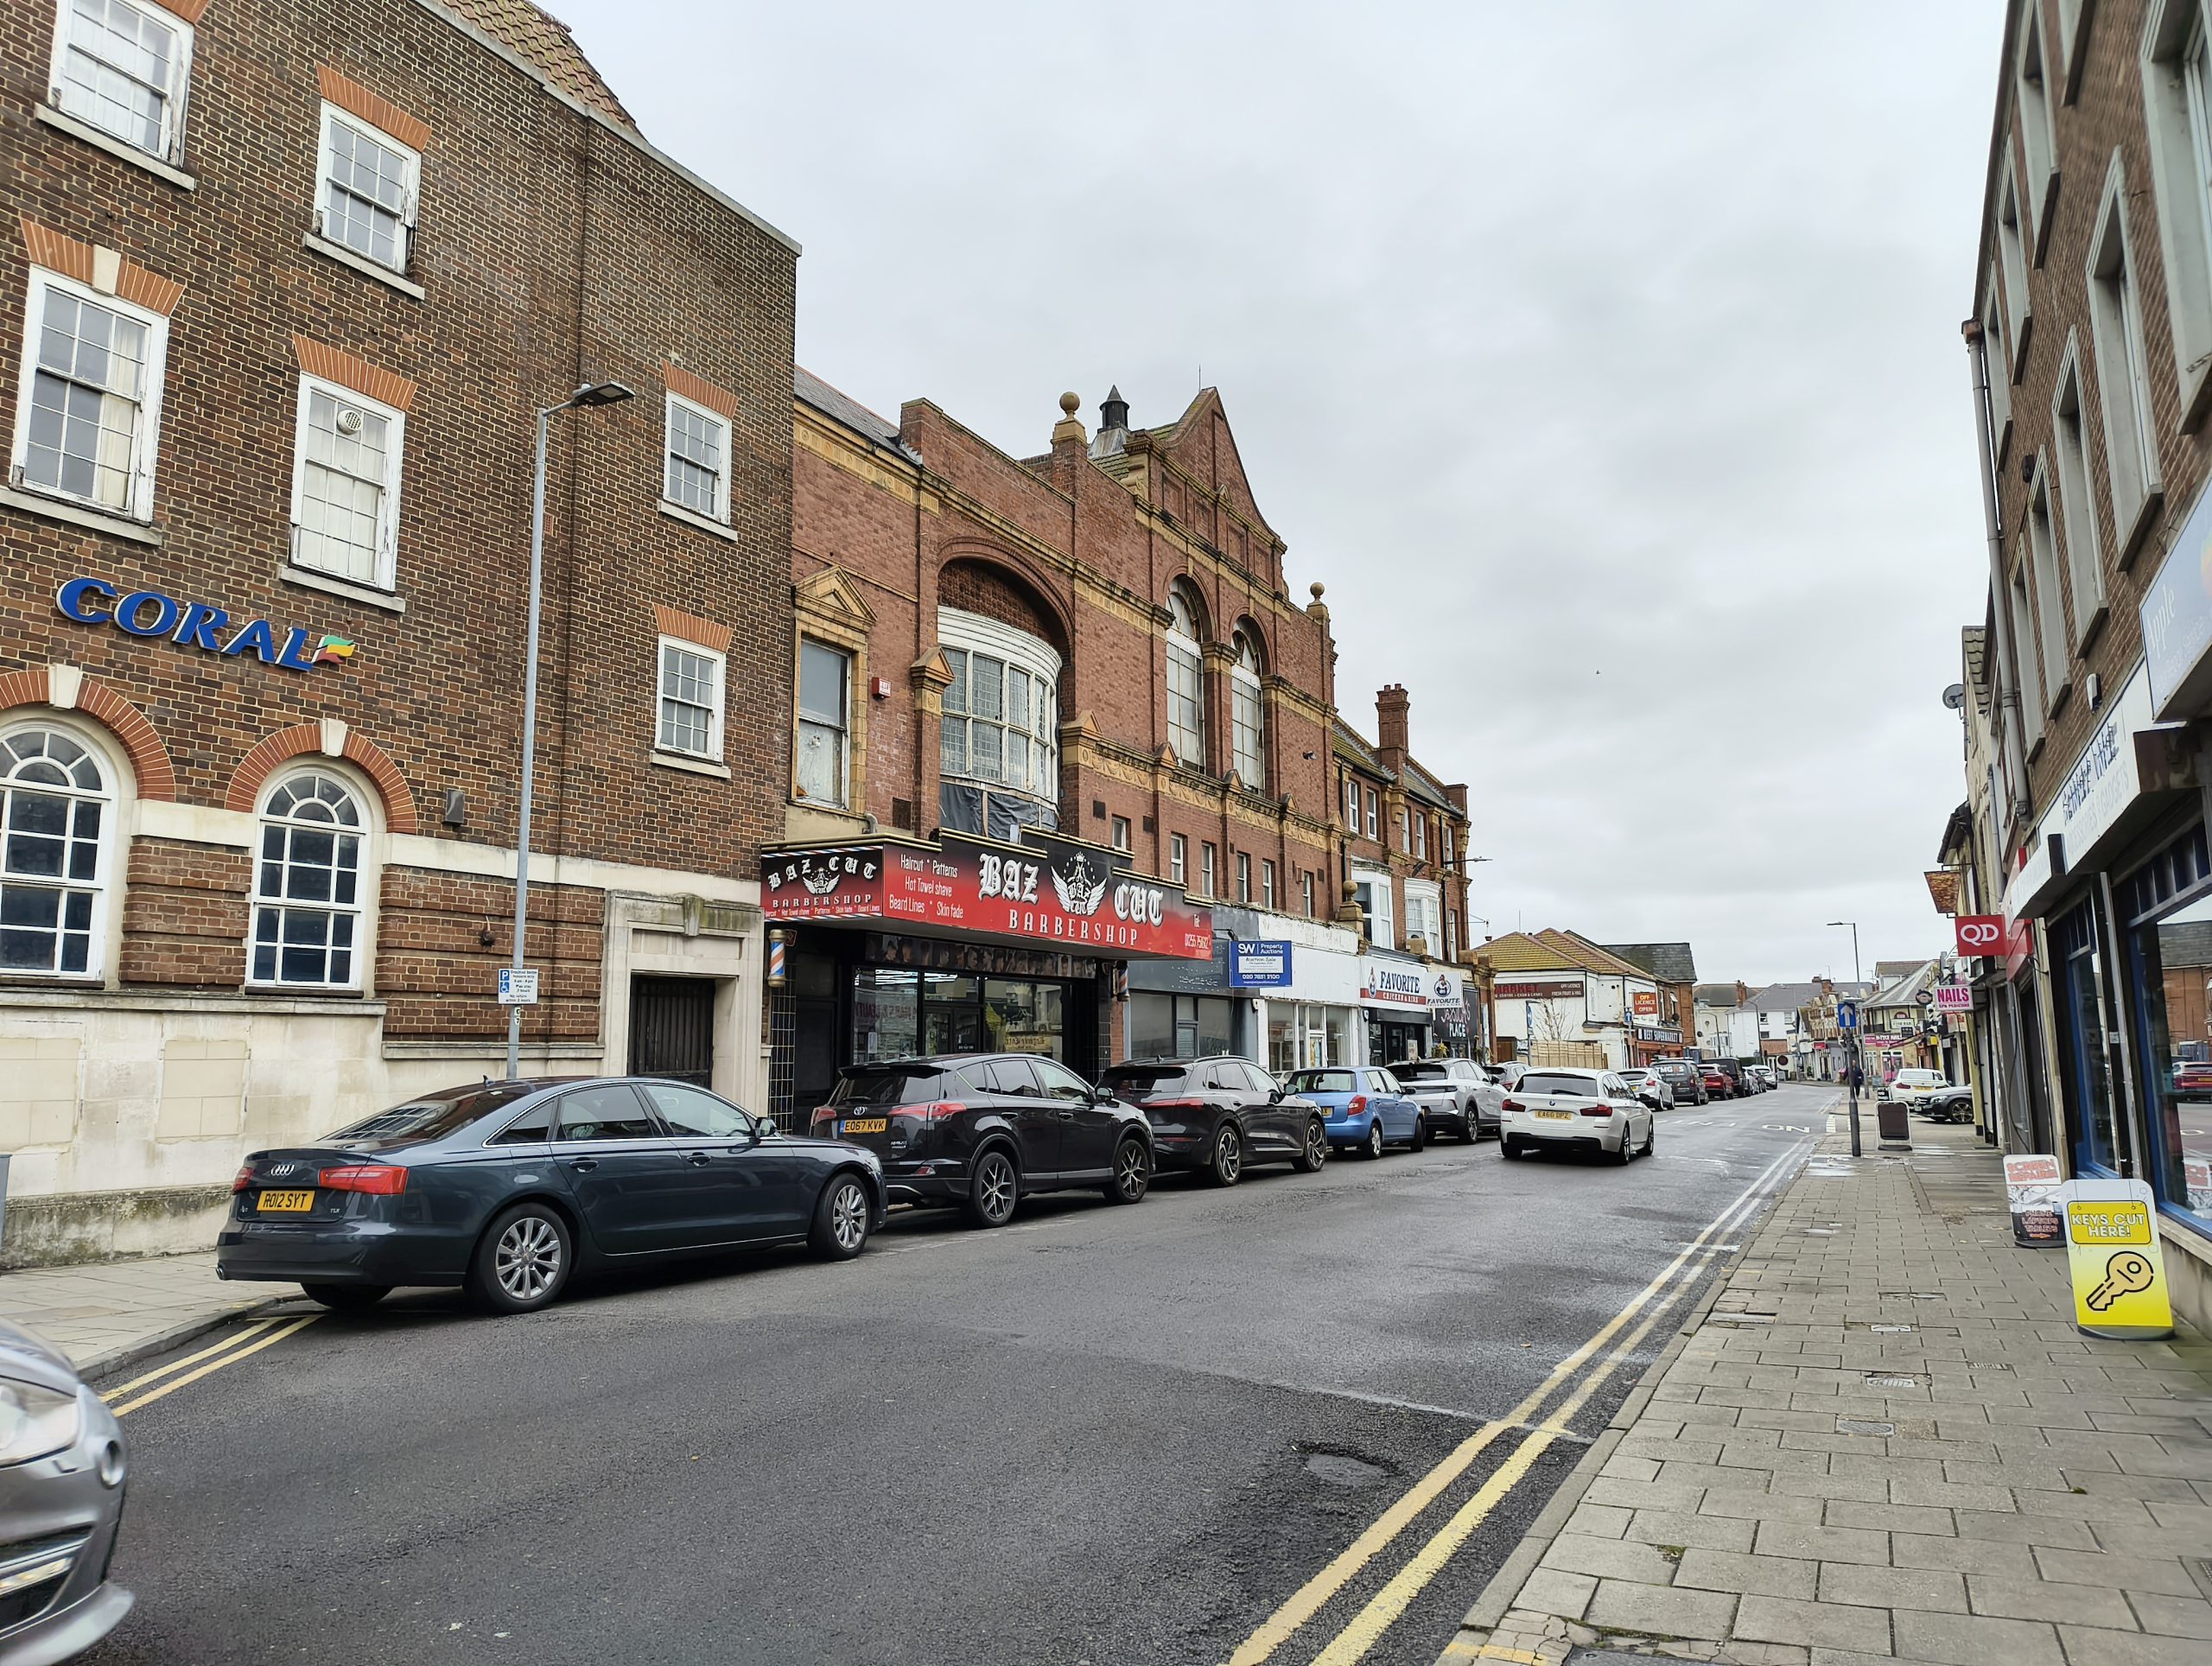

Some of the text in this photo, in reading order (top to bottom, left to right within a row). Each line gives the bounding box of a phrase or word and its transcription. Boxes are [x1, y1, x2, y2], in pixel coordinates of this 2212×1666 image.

[56, 576, 315, 671] CORAL
[2146, 582, 2176, 659] Apple
[768, 855, 877, 892] BAZ CUT
[900, 854, 958, 879] Haircut Patterns
[905, 875, 952, 897] Hot Towel shave
[978, 853, 1164, 927] BAZ CUT
[772, 894, 872, 908] BARBERSHOP
[889, 894, 963, 919] Beard Lines Skin fade
[1008, 909, 1138, 946] BARBERSHOP
[1960, 923, 1999, 946] QD
[1238, 944, 1255, 954] SW
[1380, 971, 1421, 994] FAVORITE
[1936, 988, 1969, 1002] NAILS
[868, 1119, 885, 1130] KVK
[285, 1193, 308, 1208] SYT
[2071, 1213, 2145, 1225] KEYS CUT
[2088, 1225, 2131, 1237] HERE!
